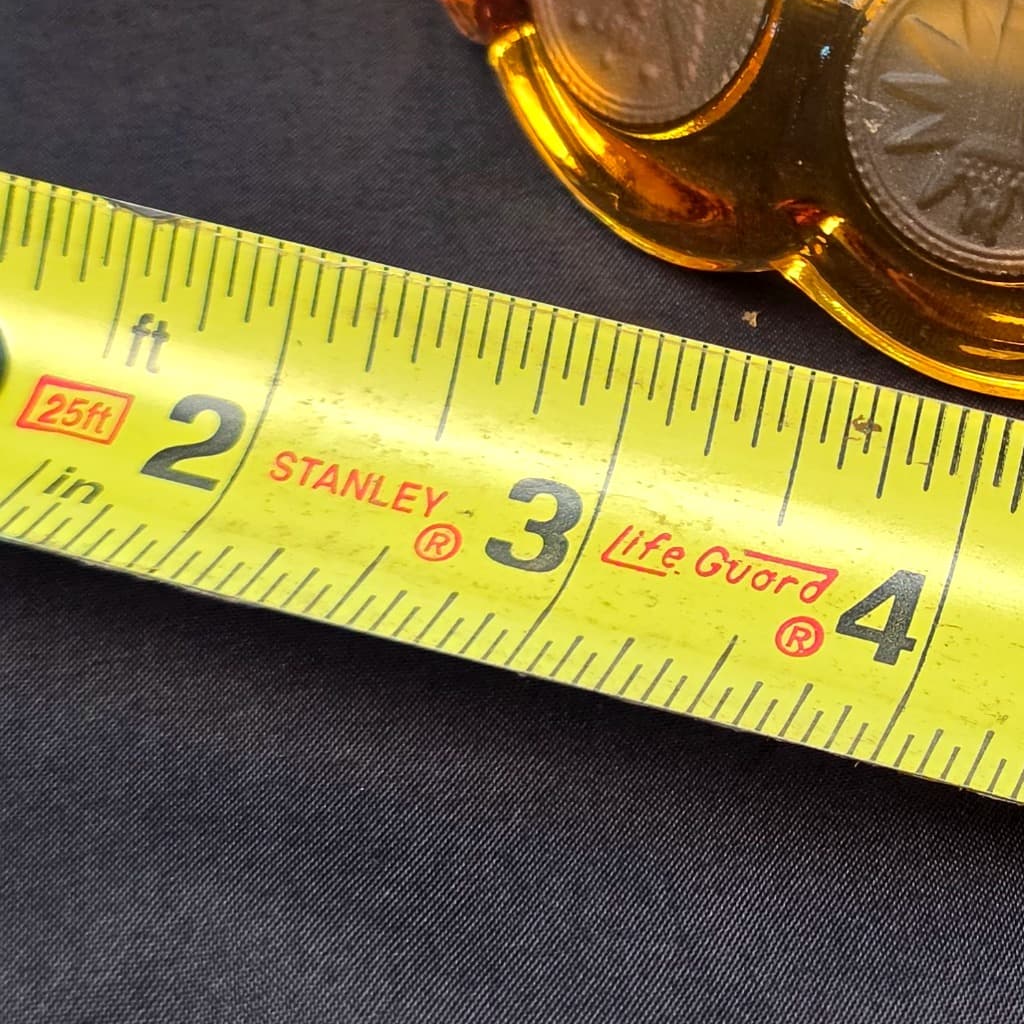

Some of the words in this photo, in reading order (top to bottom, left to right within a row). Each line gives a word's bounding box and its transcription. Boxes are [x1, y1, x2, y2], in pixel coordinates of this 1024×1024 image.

[128, 313, 170, 373] ft
[37, 396, 114, 434] 25ft
[140, 394, 246, 491] 2
[42, 466, 104, 505] in
[269, 451, 449, 518] STANLEY
[484, 477, 583, 572] 3
[695, 546, 839, 604] Guard
[835, 569, 926, 666] 4
